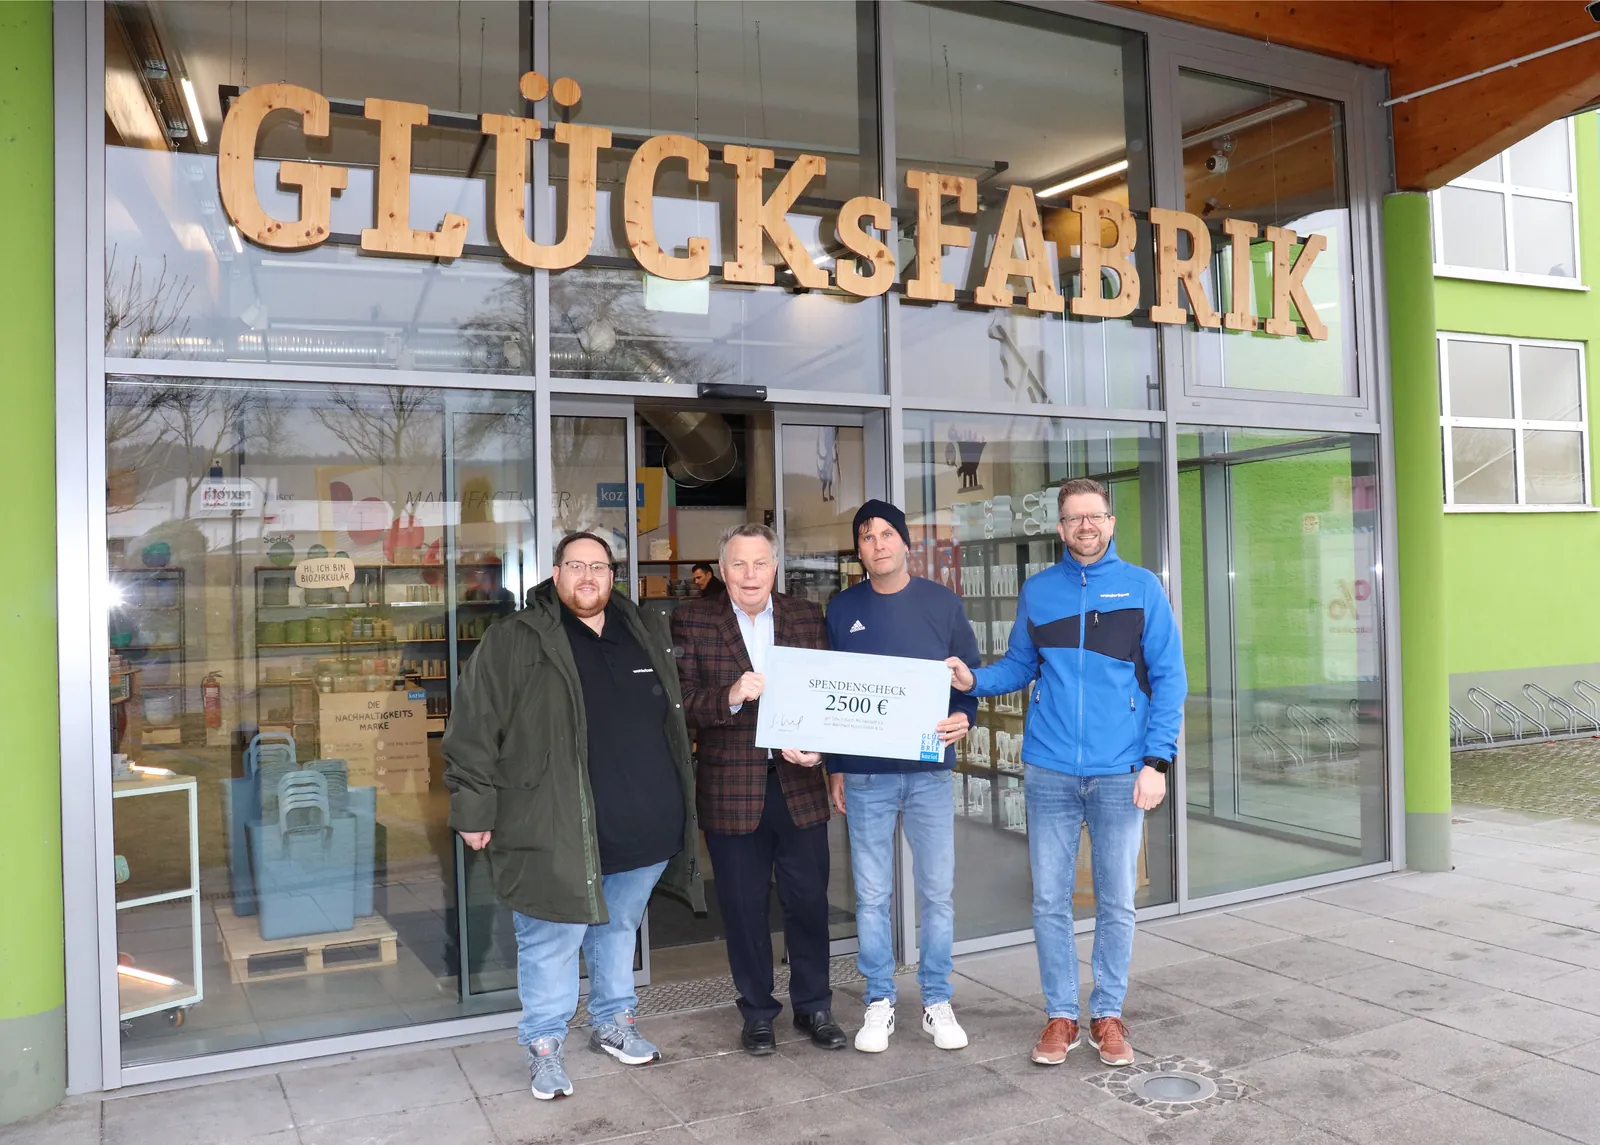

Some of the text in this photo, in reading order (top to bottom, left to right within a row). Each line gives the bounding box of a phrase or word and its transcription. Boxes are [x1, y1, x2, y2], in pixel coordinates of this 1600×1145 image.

[217, 71, 1328, 341] GLÜCKsFABRIK
[600, 487, 641, 501] kozl
[317, 564, 330, 572] ICH
[333, 563, 346, 571] BIN
[301, 572, 350, 583] BIOZIRKULÄR
[808, 678, 907, 696] SPENDENSCHECK
[367, 701, 381, 709] DIE
[825, 694, 889, 716] 2500 €
[335, 709, 413, 722] NACHHALTIGKEITS
[359, 721, 390, 731] MARKE
